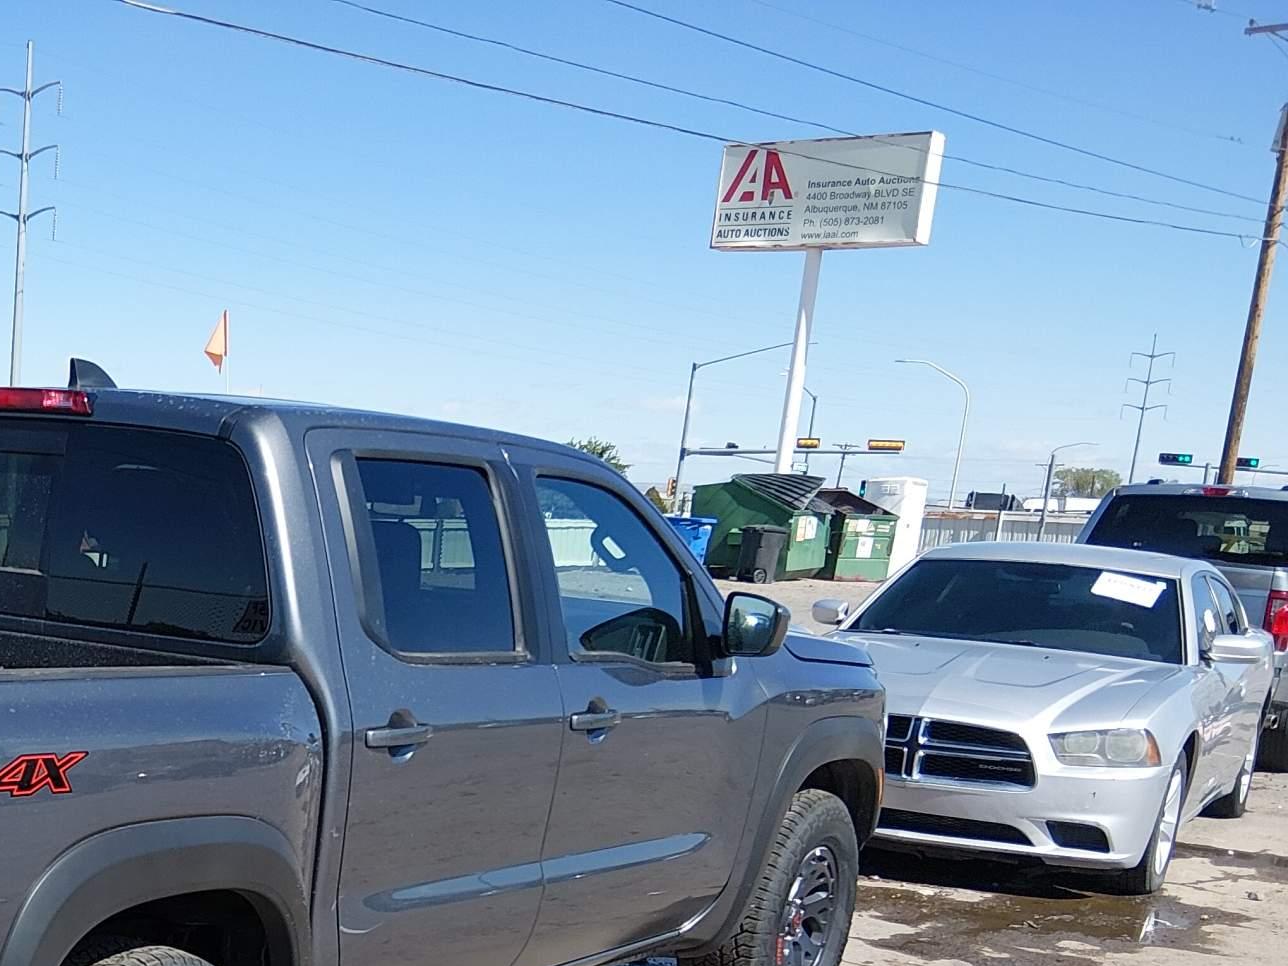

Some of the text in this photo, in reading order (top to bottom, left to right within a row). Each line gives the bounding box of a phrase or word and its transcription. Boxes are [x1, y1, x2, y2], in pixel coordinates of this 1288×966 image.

[807, 179, 852, 189] Insurance
[854, 177, 876, 186] Auto
[806, 187, 915, 201] 4400 Broadway BLVD SE
[862, 203, 878, 211] NM
[880, 200, 908, 210] 87105
[718, 209, 792, 222] INSURANCE
[819, 217, 842, 228] (505)
[844, 216, 884, 226] 873-2081
[716, 227, 790, 239] AUTO AUCTIONS
[801, 230, 859, 240] www.iaai.com
